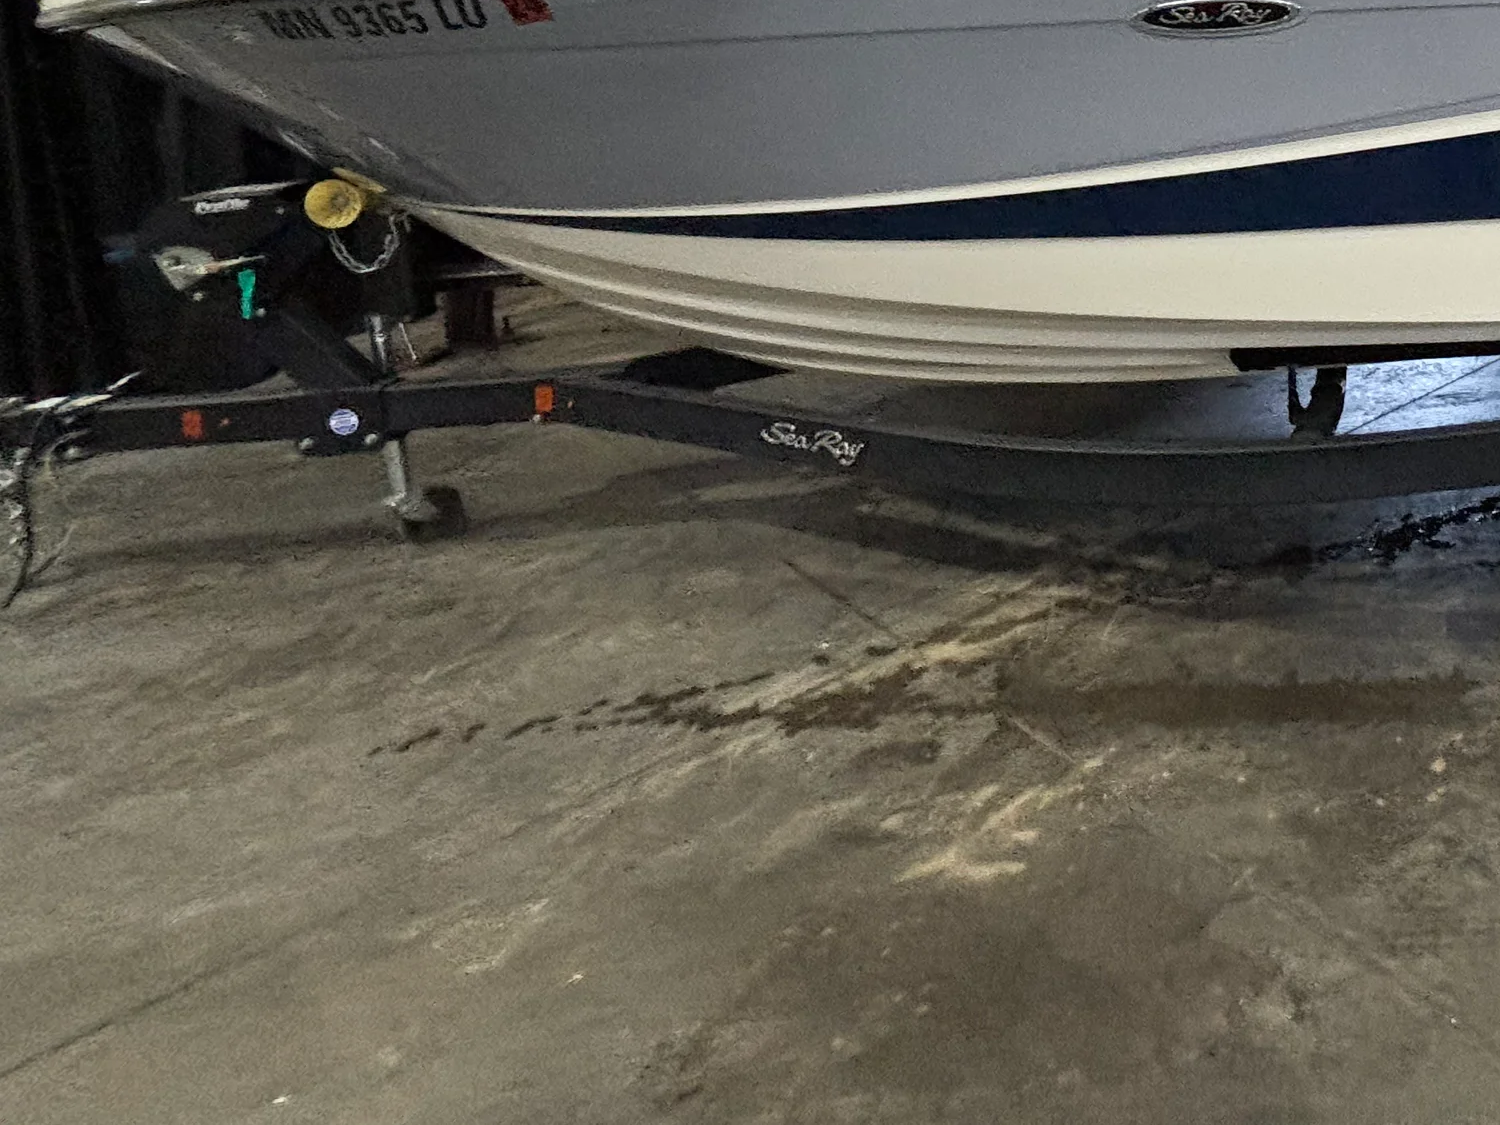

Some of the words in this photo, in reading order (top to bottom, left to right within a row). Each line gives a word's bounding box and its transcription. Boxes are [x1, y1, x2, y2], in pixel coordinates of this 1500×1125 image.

[1159, 6, 1212, 25] Sea
[759, 422, 812, 450] Sea
[810, 429, 865, 466] Ray
